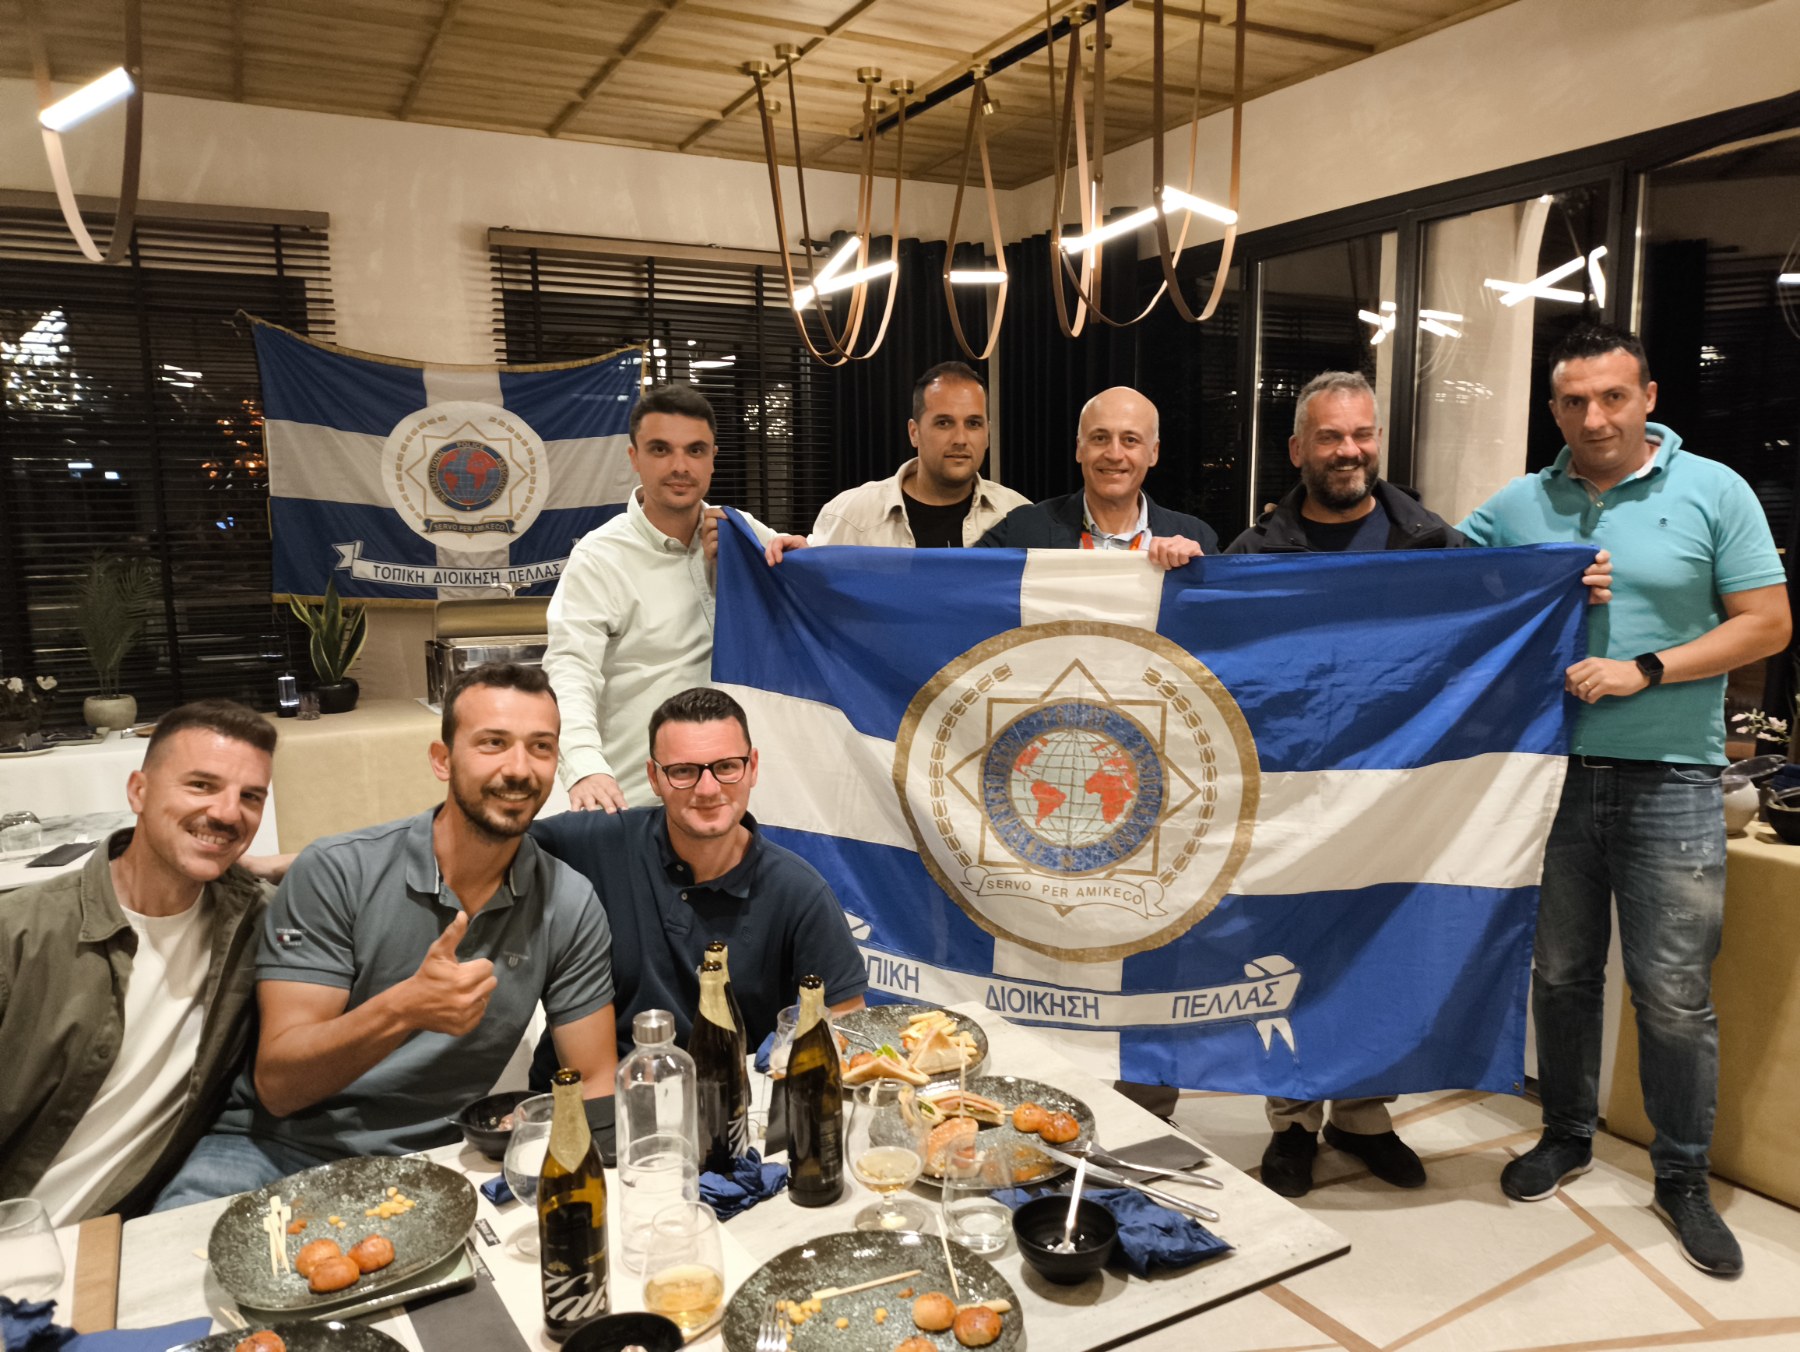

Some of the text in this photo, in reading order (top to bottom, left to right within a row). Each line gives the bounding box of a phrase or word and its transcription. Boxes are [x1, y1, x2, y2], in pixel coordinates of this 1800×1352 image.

[433, 522, 458, 531] SERVO
[373, 563, 560, 584] ΤΟΠΙΚΗ ΔΙΟΙΚΗΣΗ ΠΕΛΛΑΣ
[986, 879, 1142, 905] SERVO PER AMIKECO
[867, 954, 1280, 1020] ΠΙΚΗ ΔΙΟΙΚΗΣΗ ΠΕΛΛΑΣ
